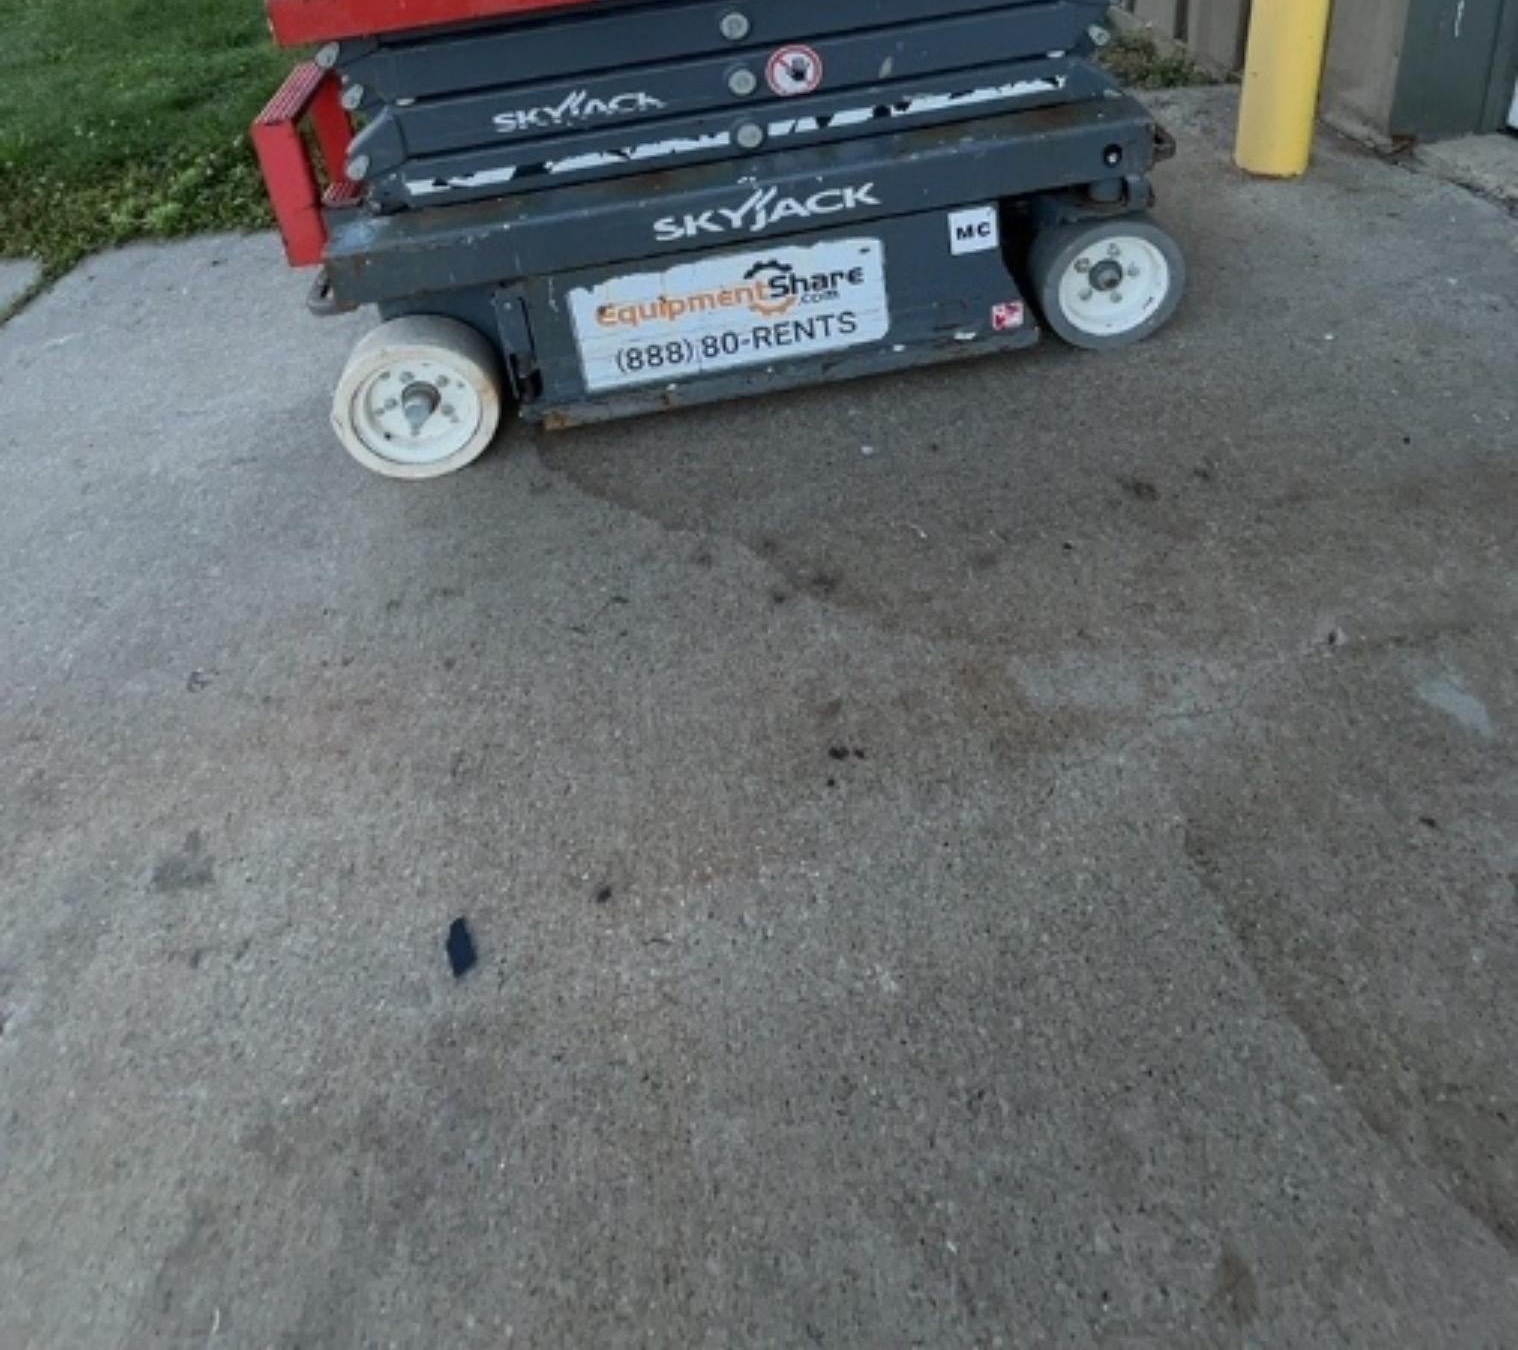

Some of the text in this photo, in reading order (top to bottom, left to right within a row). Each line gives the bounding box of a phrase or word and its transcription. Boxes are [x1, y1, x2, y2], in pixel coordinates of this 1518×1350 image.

[652, 182, 881, 242] SKYJACK
[615, 311, 857, 373] (888) 80-RENTS
